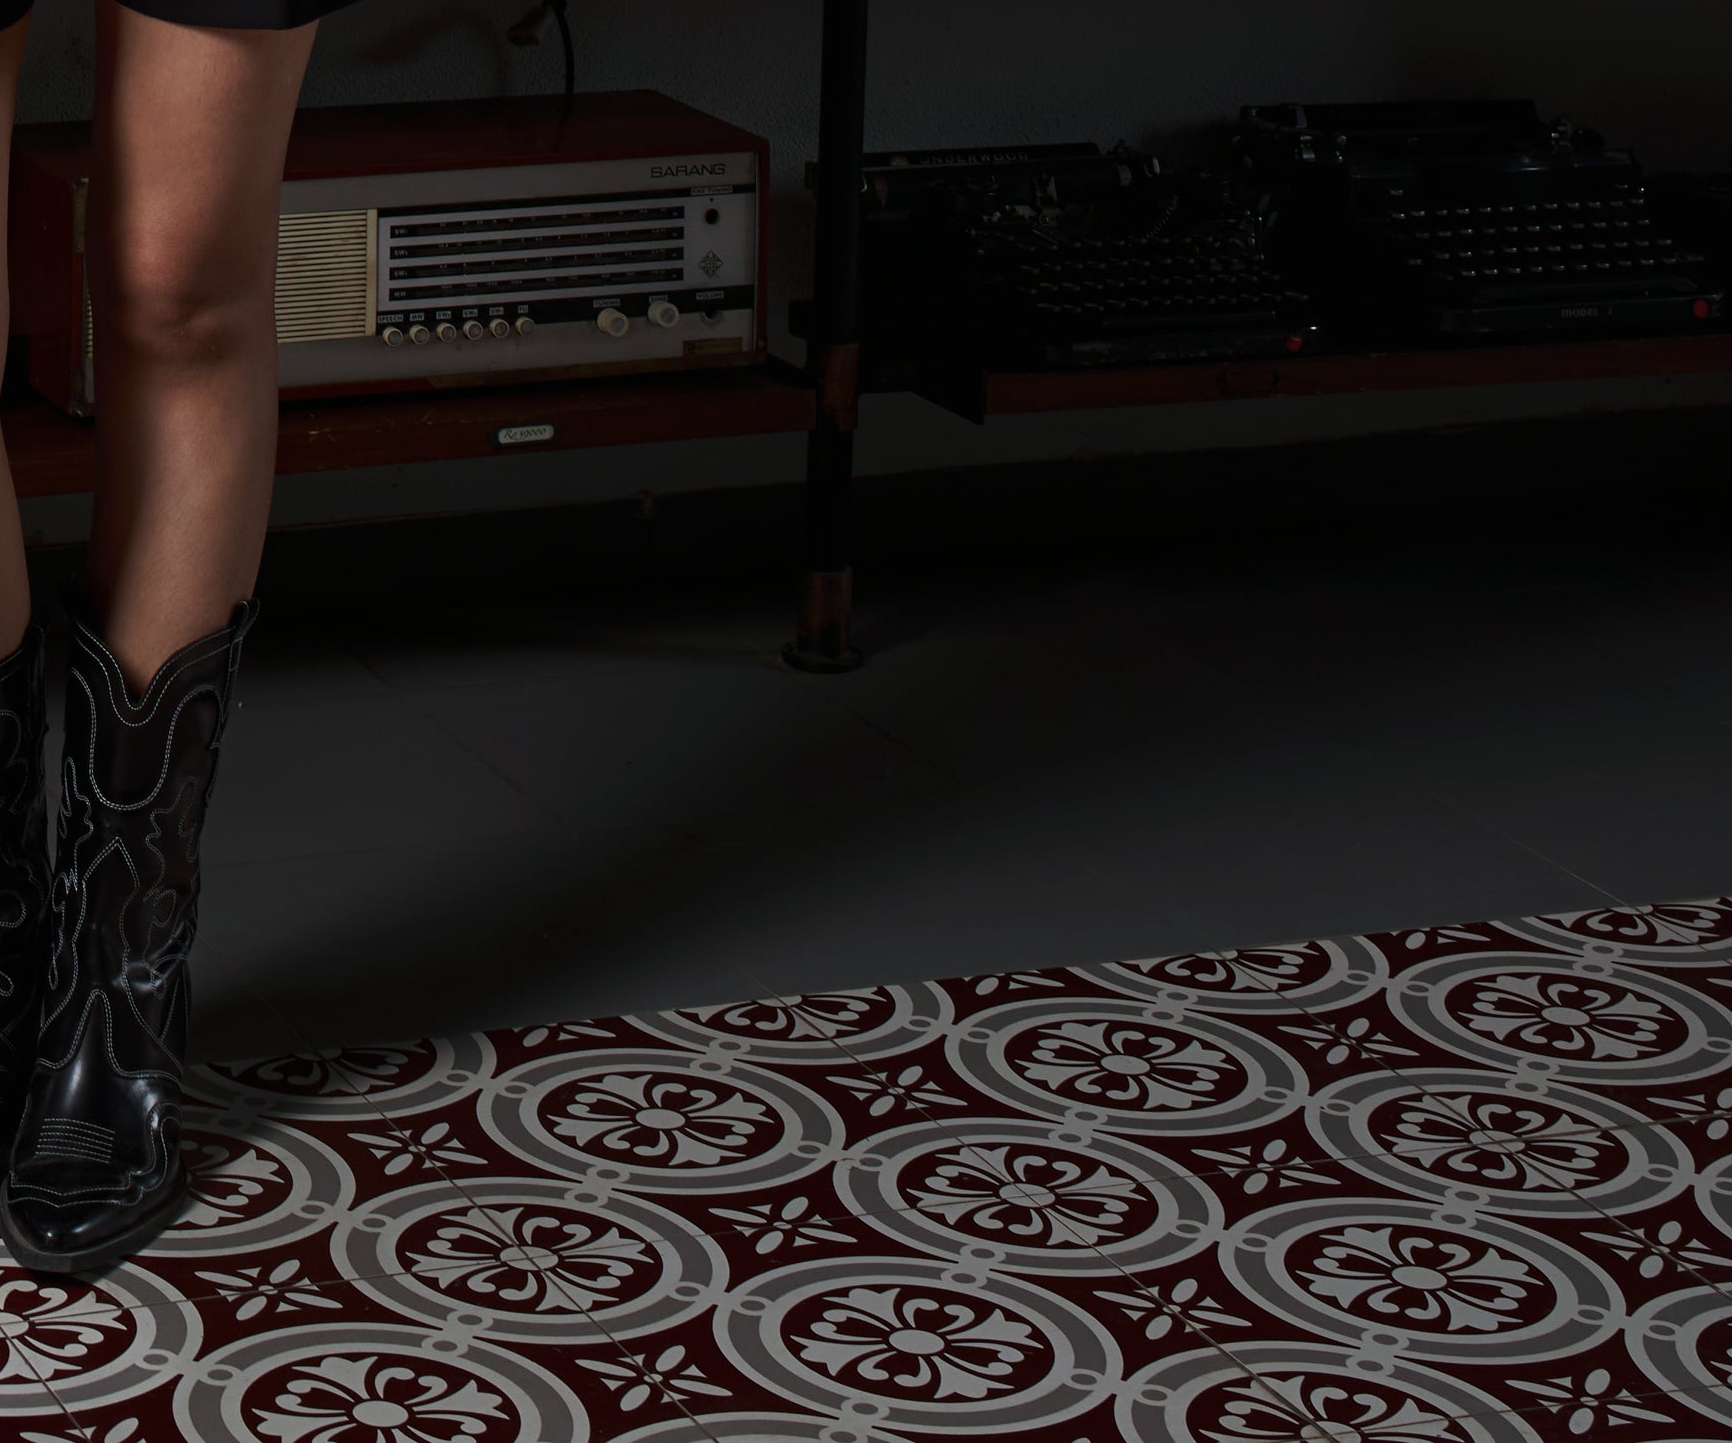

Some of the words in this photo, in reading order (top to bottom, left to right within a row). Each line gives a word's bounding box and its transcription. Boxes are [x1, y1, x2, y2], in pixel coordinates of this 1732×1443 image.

[919, 151, 1029, 164] UNDERWOOD
[650, 163, 726, 178] SARANG
[393, 290, 408, 298] MW
[698, 291, 724, 299] VOLUME
[594, 299, 620, 307] TUNING
